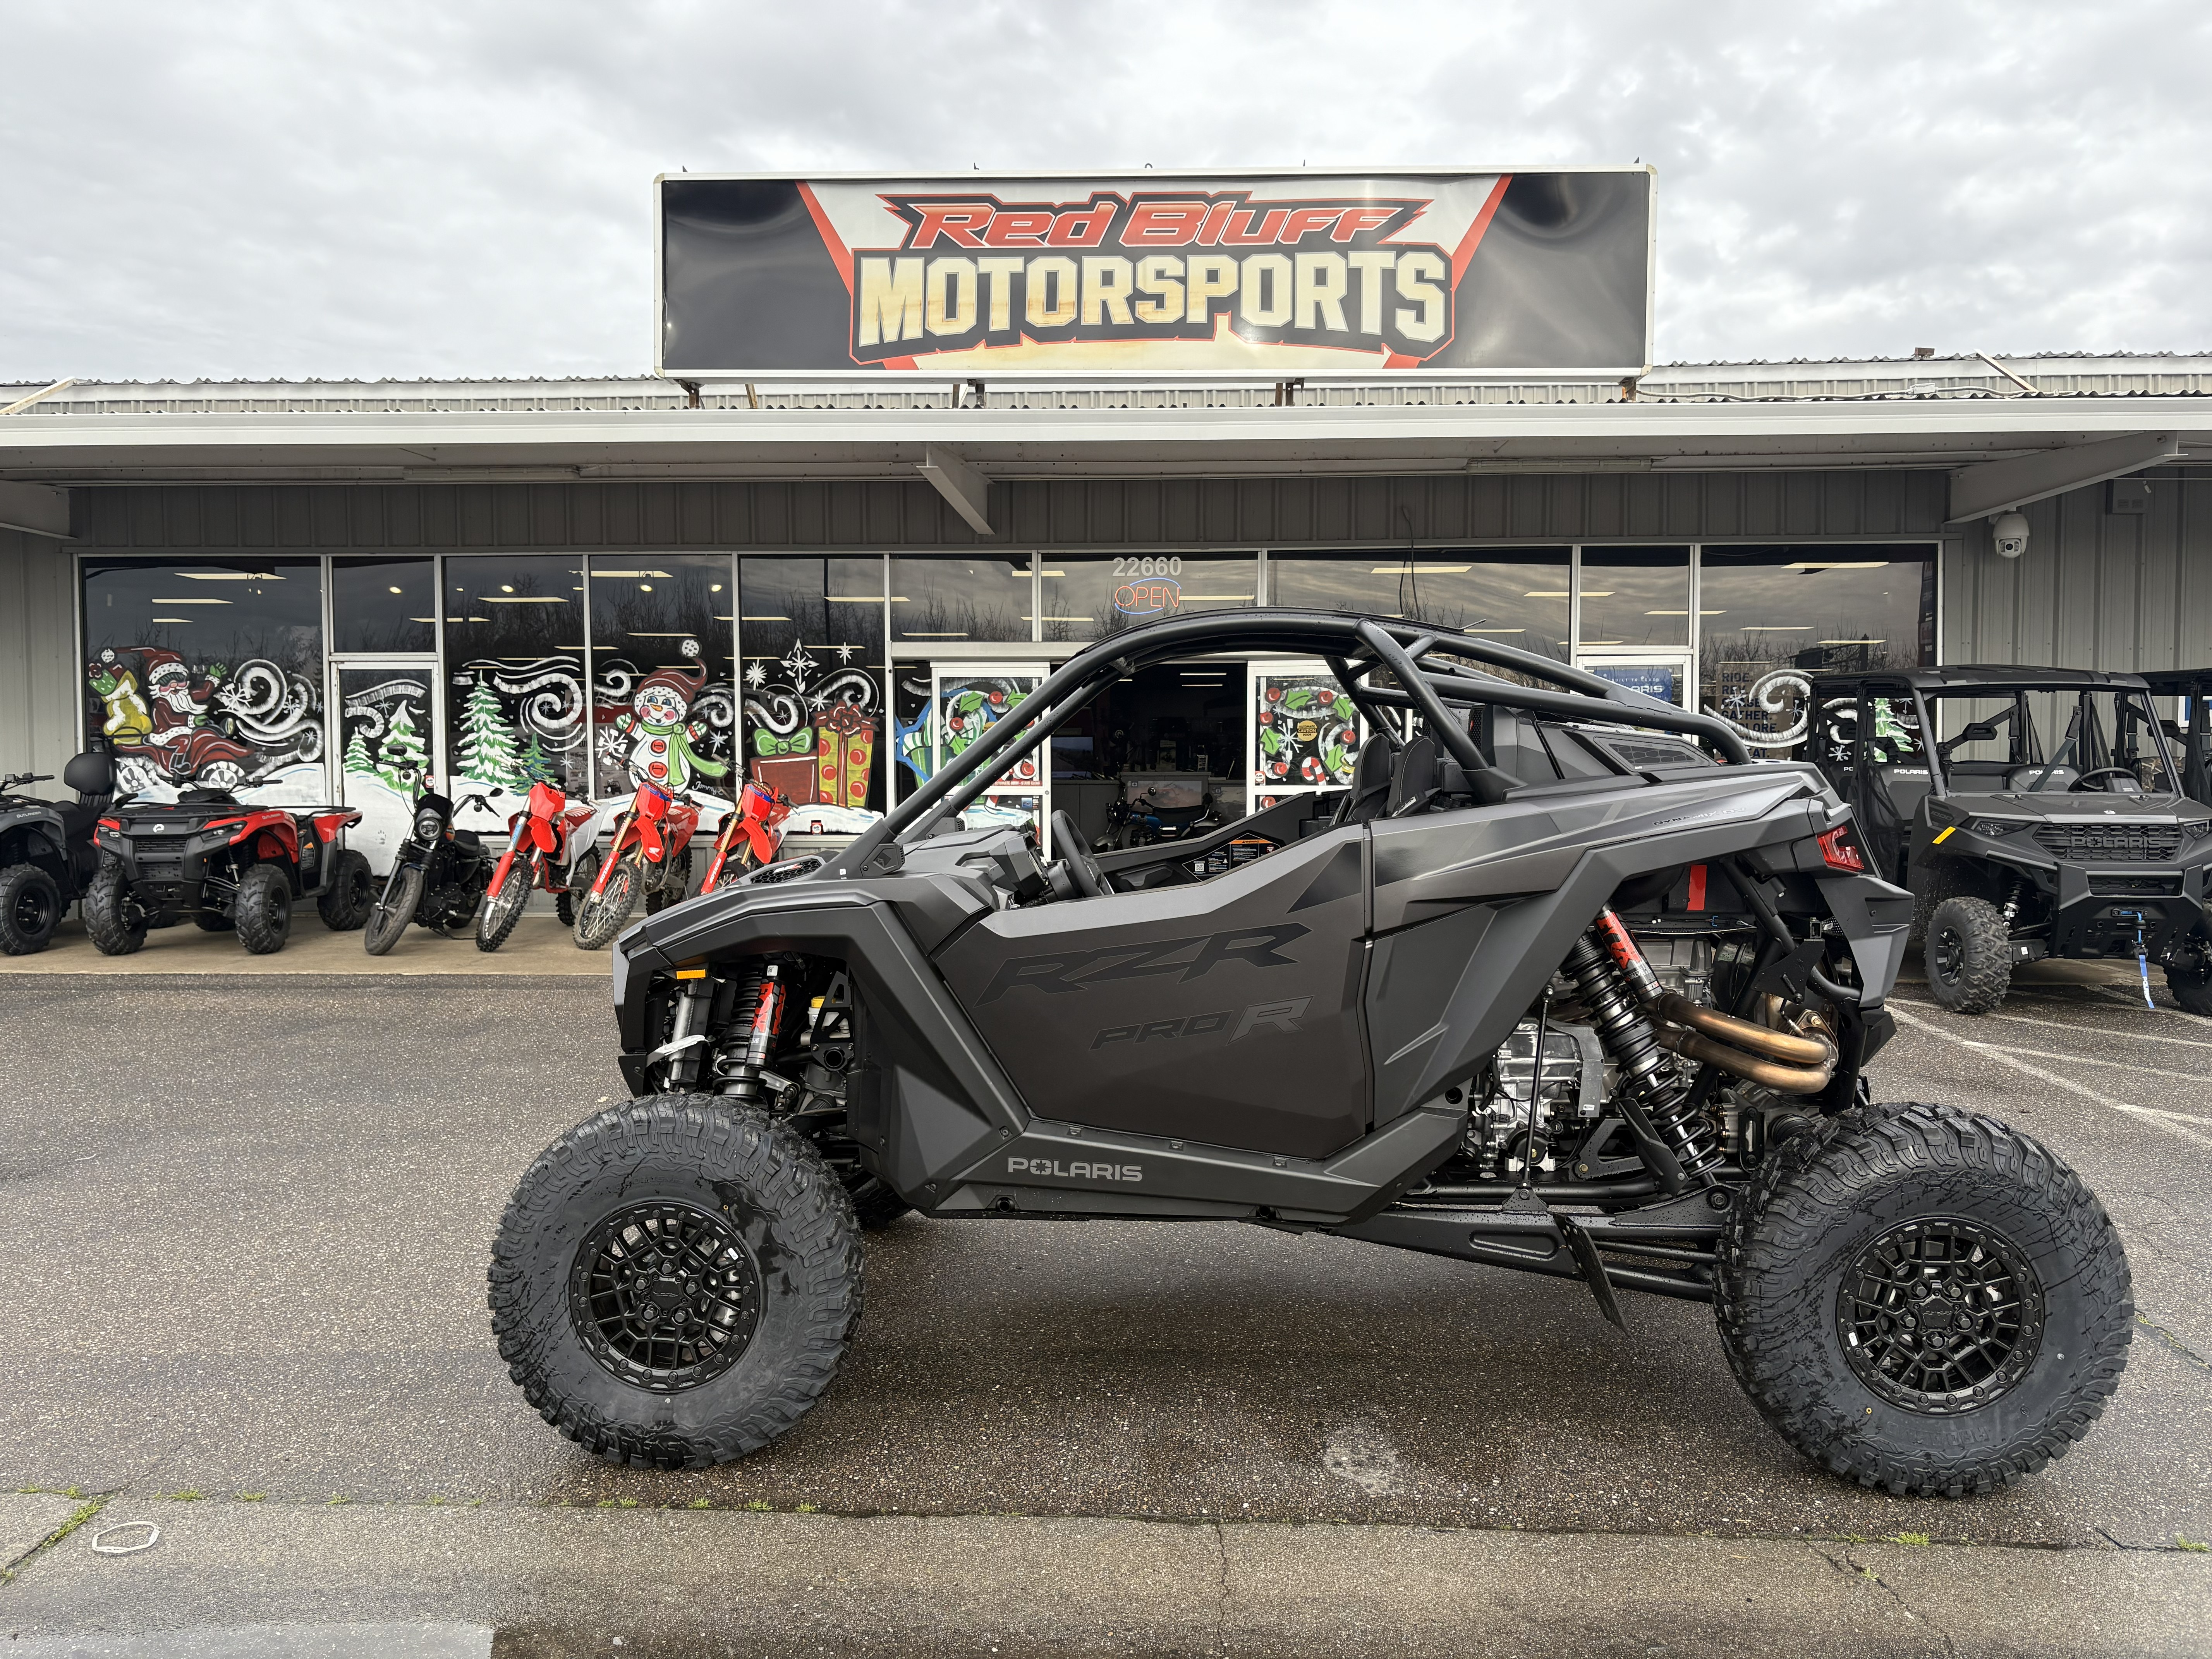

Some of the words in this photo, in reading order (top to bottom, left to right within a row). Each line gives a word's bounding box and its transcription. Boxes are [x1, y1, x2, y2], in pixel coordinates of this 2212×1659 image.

[907, 201, 1118, 249] Red
[859, 251, 1445, 347] MOTORSPORTS
[1113, 556, 1182, 576] 22660
[1115, 586, 1179, 607] OPEN
[1722, 673, 1753, 682] RIDE.
[1653, 811, 1717, 825] DYNAMIX
[2071, 836, 2161, 848] POLARIS
[973, 922, 1313, 1008] RZR
[1089, 1010, 1233, 1051] PRO
[1008, 1157, 1143, 1182] POLARIS
